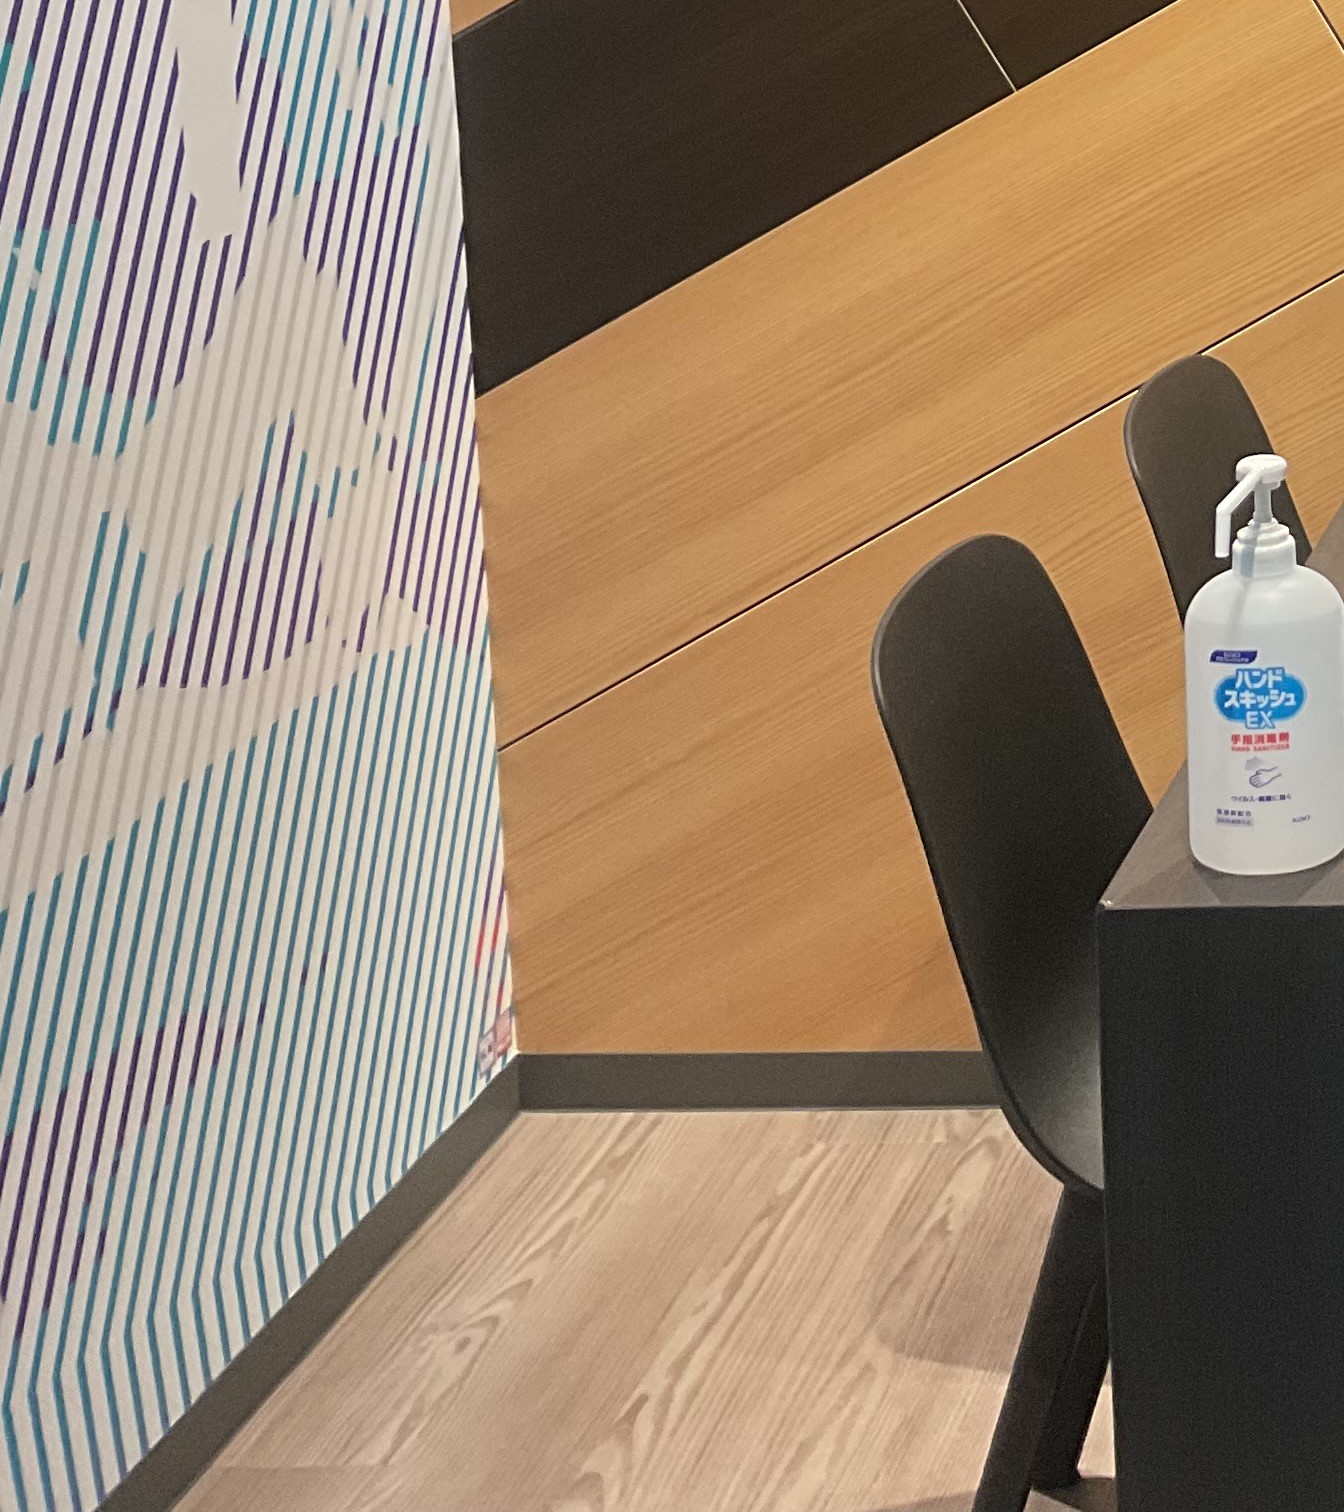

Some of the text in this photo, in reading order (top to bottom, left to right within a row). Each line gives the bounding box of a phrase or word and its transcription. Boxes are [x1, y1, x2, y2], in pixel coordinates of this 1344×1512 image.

[1234, 668, 1284, 689] ハンド
[1223, 688, 1297, 709] スキッシュ
[1246, 710, 1275, 730] EX
